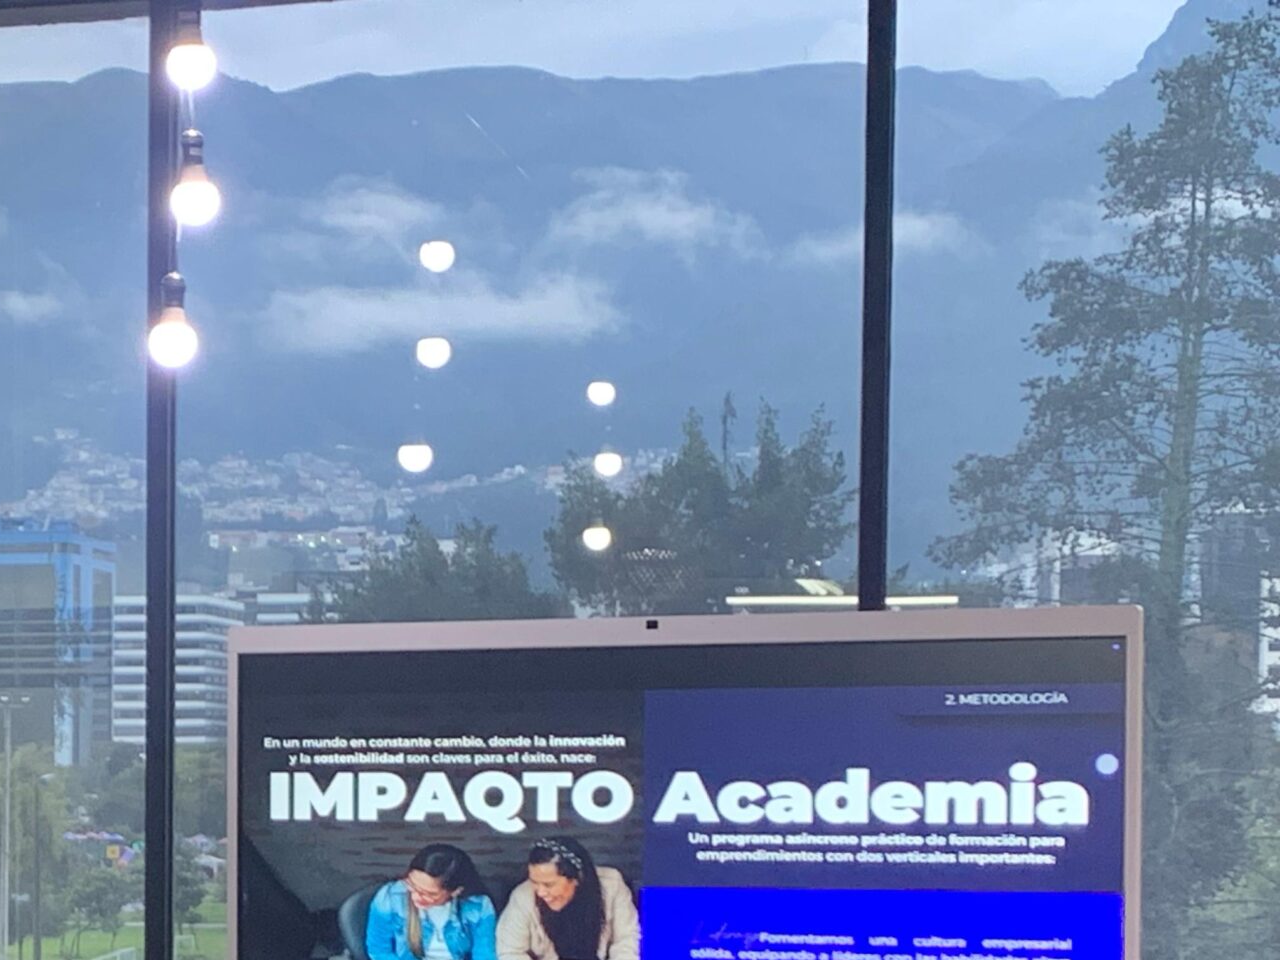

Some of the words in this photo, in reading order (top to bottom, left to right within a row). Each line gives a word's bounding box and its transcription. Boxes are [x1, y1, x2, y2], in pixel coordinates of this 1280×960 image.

[958, 691, 1069, 705] METODOLOGÍA
[264, 737, 280, 748] En
[283, 738, 300, 748] un
[303, 736, 347, 748] mundo
[350, 738, 366, 748] en
[370, 737, 431, 748] constante
[433, 736, 486, 748] cambio,
[489, 735, 531, 747] donde
[534, 735, 547, 747] la
[549, 734, 626, 747] innovación
[289, 754, 297, 766] y
[300, 753, 311, 764] la
[313, 752, 403, 764] sostenibilidad
[406, 754, 429, 764] son
[431, 752, 471, 764] claves
[474, 754, 503, 766] para
[506, 752, 519, 763] el
[522, 752, 558, 764] éxito,
[560, 753, 597, 764] nace:
[270, 770, 634, 833] IMPAQTO
[652, 762, 1089, 825] Academia
[688, 832, 709, 844] Un
[711, 833, 784, 847] programa
[861, 833, 924, 848] práctico
[925, 834, 947, 846] de
[948, 834, 1027, 846] formación
[1029, 836, 1066, 849] para
[696, 850, 823, 864] emprendimientos
[825, 852, 853, 862] con
[855, 851, 884, 863] dos
[886, 851, 957, 863] verticales
[759, 931, 855, 945] Fomentamos
[868, 936, 898, 946] una
[912, 936, 967, 948] cultura
[981, 938, 1072, 951] empresarial
